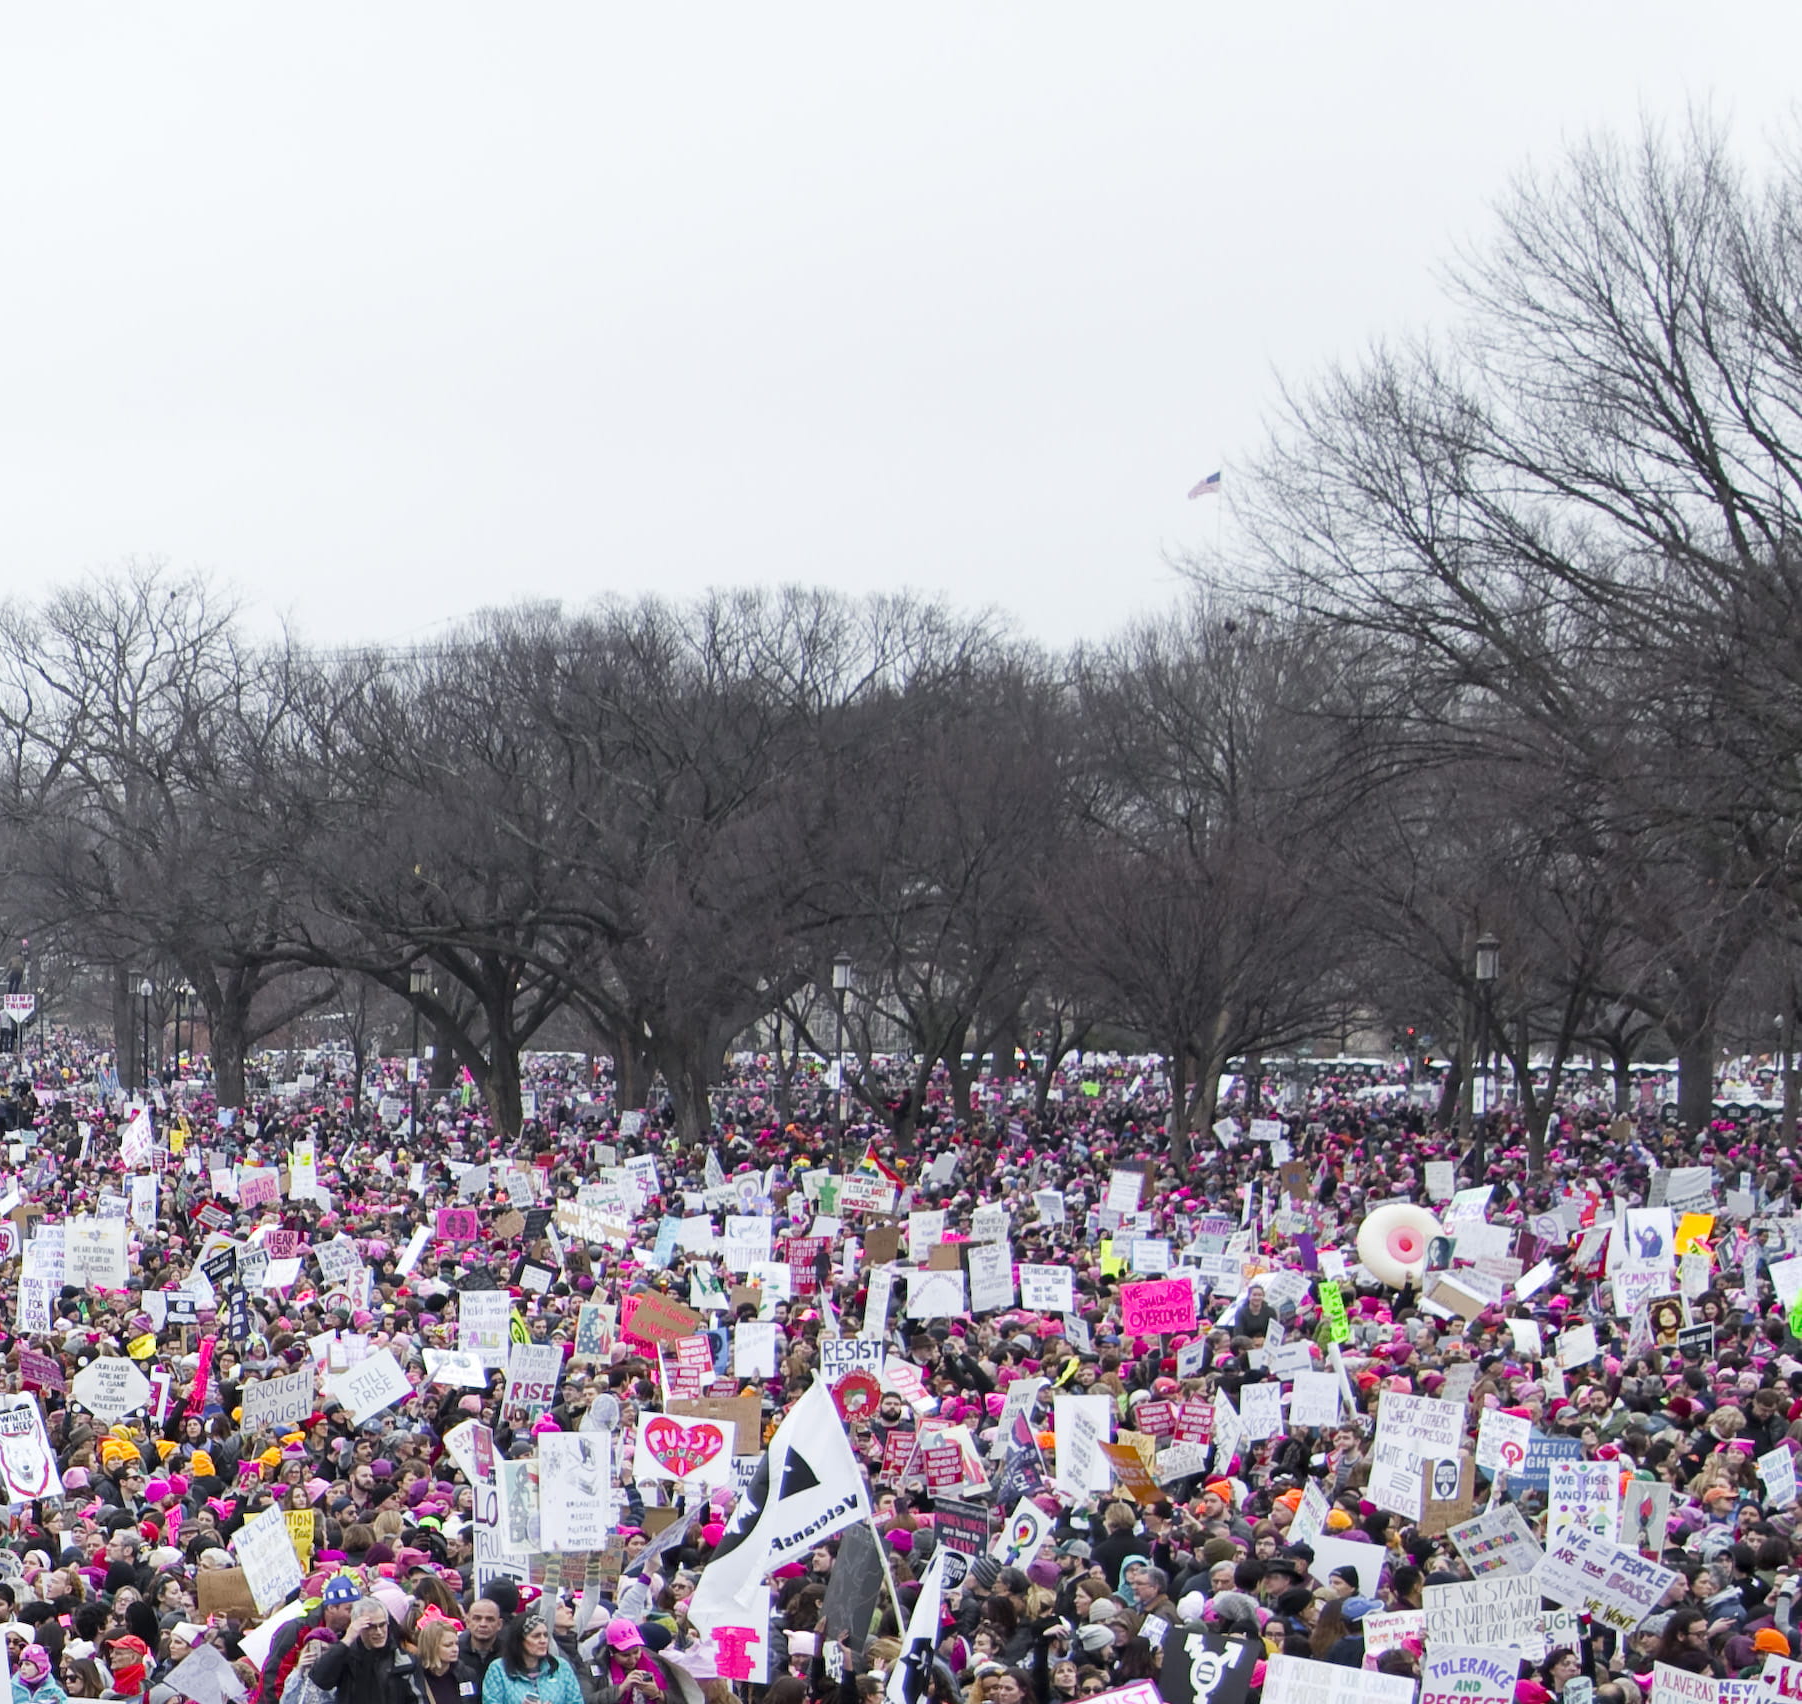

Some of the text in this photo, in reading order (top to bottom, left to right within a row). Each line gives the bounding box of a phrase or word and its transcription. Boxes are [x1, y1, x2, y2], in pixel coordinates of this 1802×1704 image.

[5, 994, 33, 1002] DUMP
[823, 1341, 881, 1362] RESIST
[1428, 1656, 1515, 1691] TOLERANCE
[1453, 1678, 1482, 1693] AND
